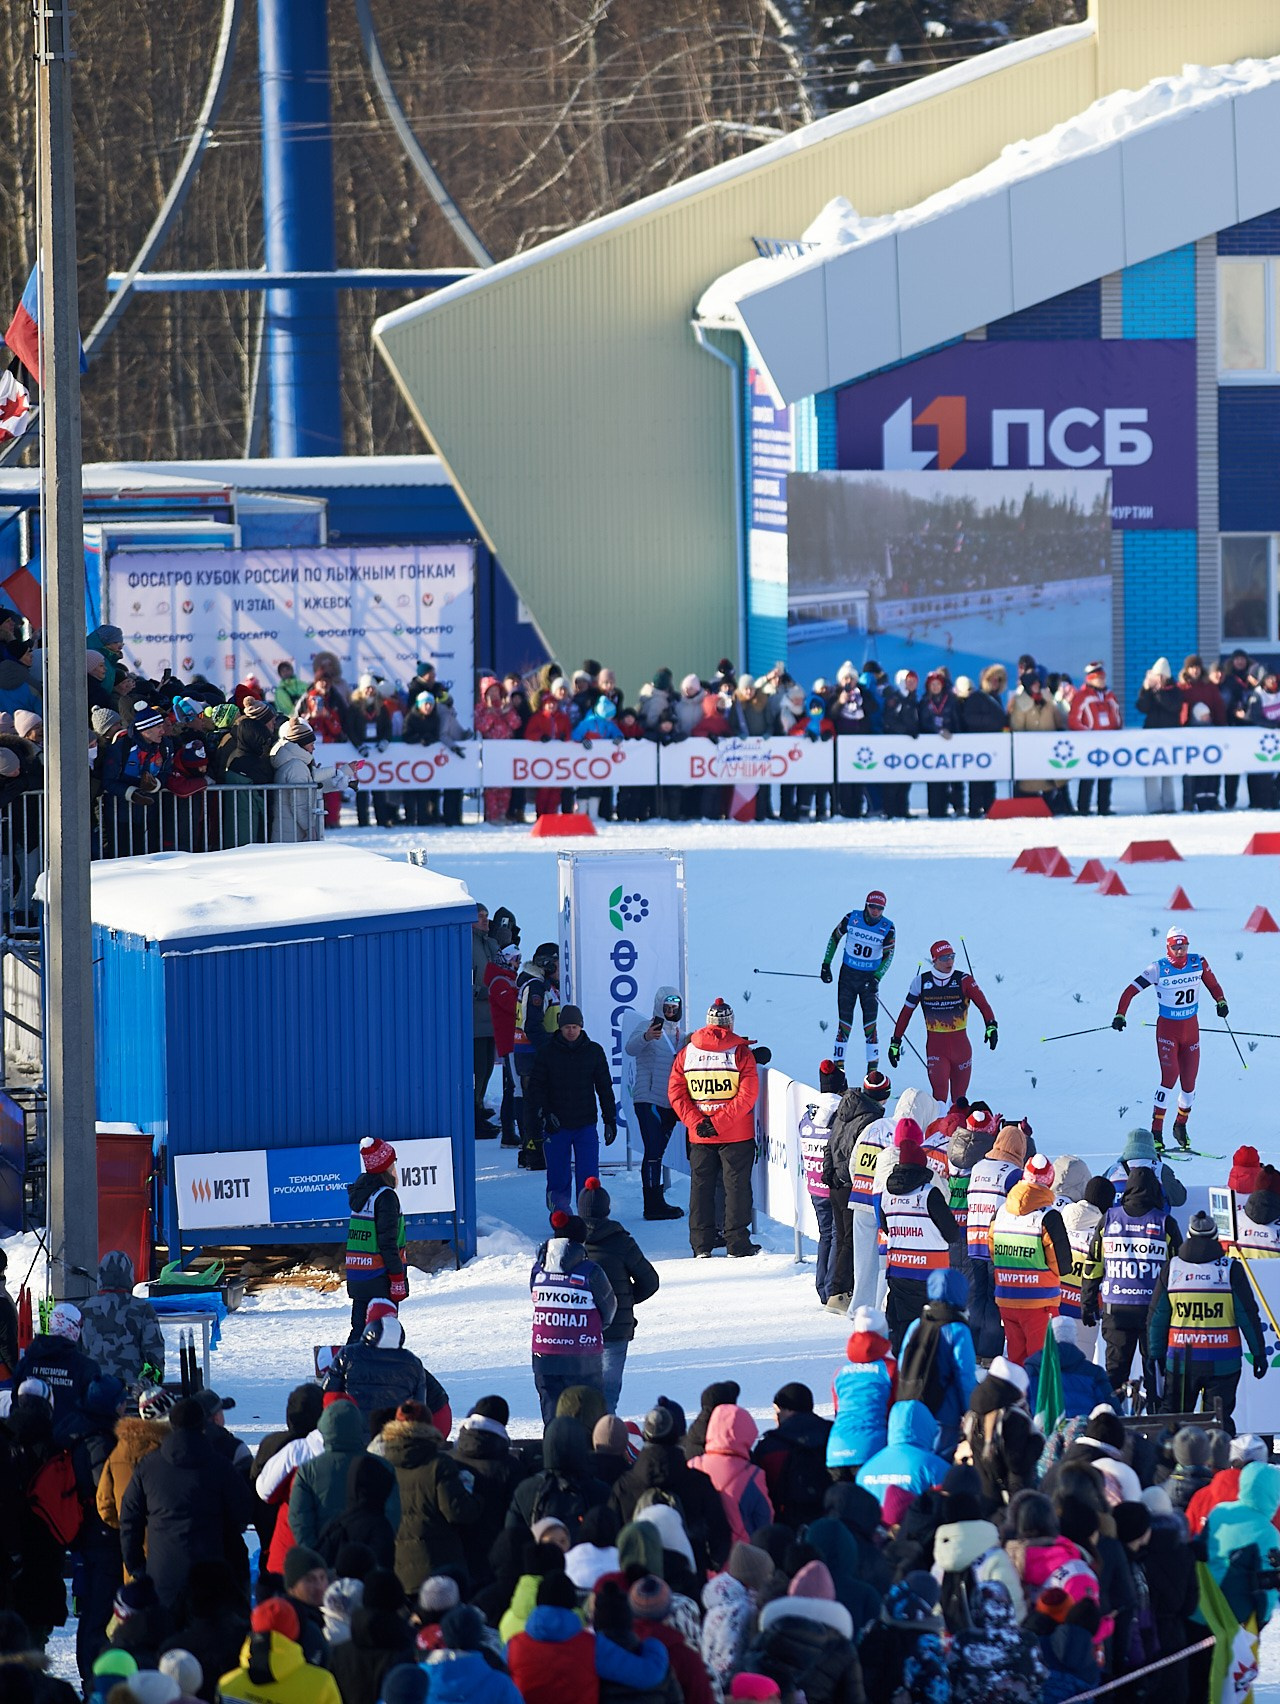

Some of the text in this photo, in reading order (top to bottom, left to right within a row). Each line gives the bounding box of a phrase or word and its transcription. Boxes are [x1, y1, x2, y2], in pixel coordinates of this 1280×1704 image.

[992, 407, 1153, 467] ПСБ
[128, 564, 455, 588] ФОСАГРО КУБОК РОССИИ ПО ЛЫЖНЫМ ГОНКАМ
[247, 599, 275, 611] ЭТАП
[304, 596, 352, 609] ИЖЕВСК
[884, 753, 992, 770] ФОСАГРО
[1087, 744, 1222, 767] ФОСАГРО
[513, 758, 611, 780] BOSCO
[854, 943, 872, 958] 30
[1175, 988, 1195, 1006] 20
[690, 1079, 732, 1094] СУДЬЯ
[1000, 1164, 1008, 1172] 2
[289, 1173, 341, 1185] ТЕХНОПАРК
[402, 1165, 438, 1187] ИЗТТ
[214, 1178, 250, 1200] ИЗТТ
[273, 1184, 325, 1195] РУСКЛИМАТ
[994, 1244, 1036, 1258] ВОЛОНТЕР
[1114, 1241, 1165, 1256] ЛУКОЙЛ
[1106, 1260, 1161, 1279] ЖЮРИ
[1214, 1258, 1229, 1266] 33
[538, 1292, 587, 1304] ЛУКОЙЛ
[1176, 1302, 1224, 1320] СУДЬЯ
[1173, 1333, 1229, 1344] УДМУРТИЯ
